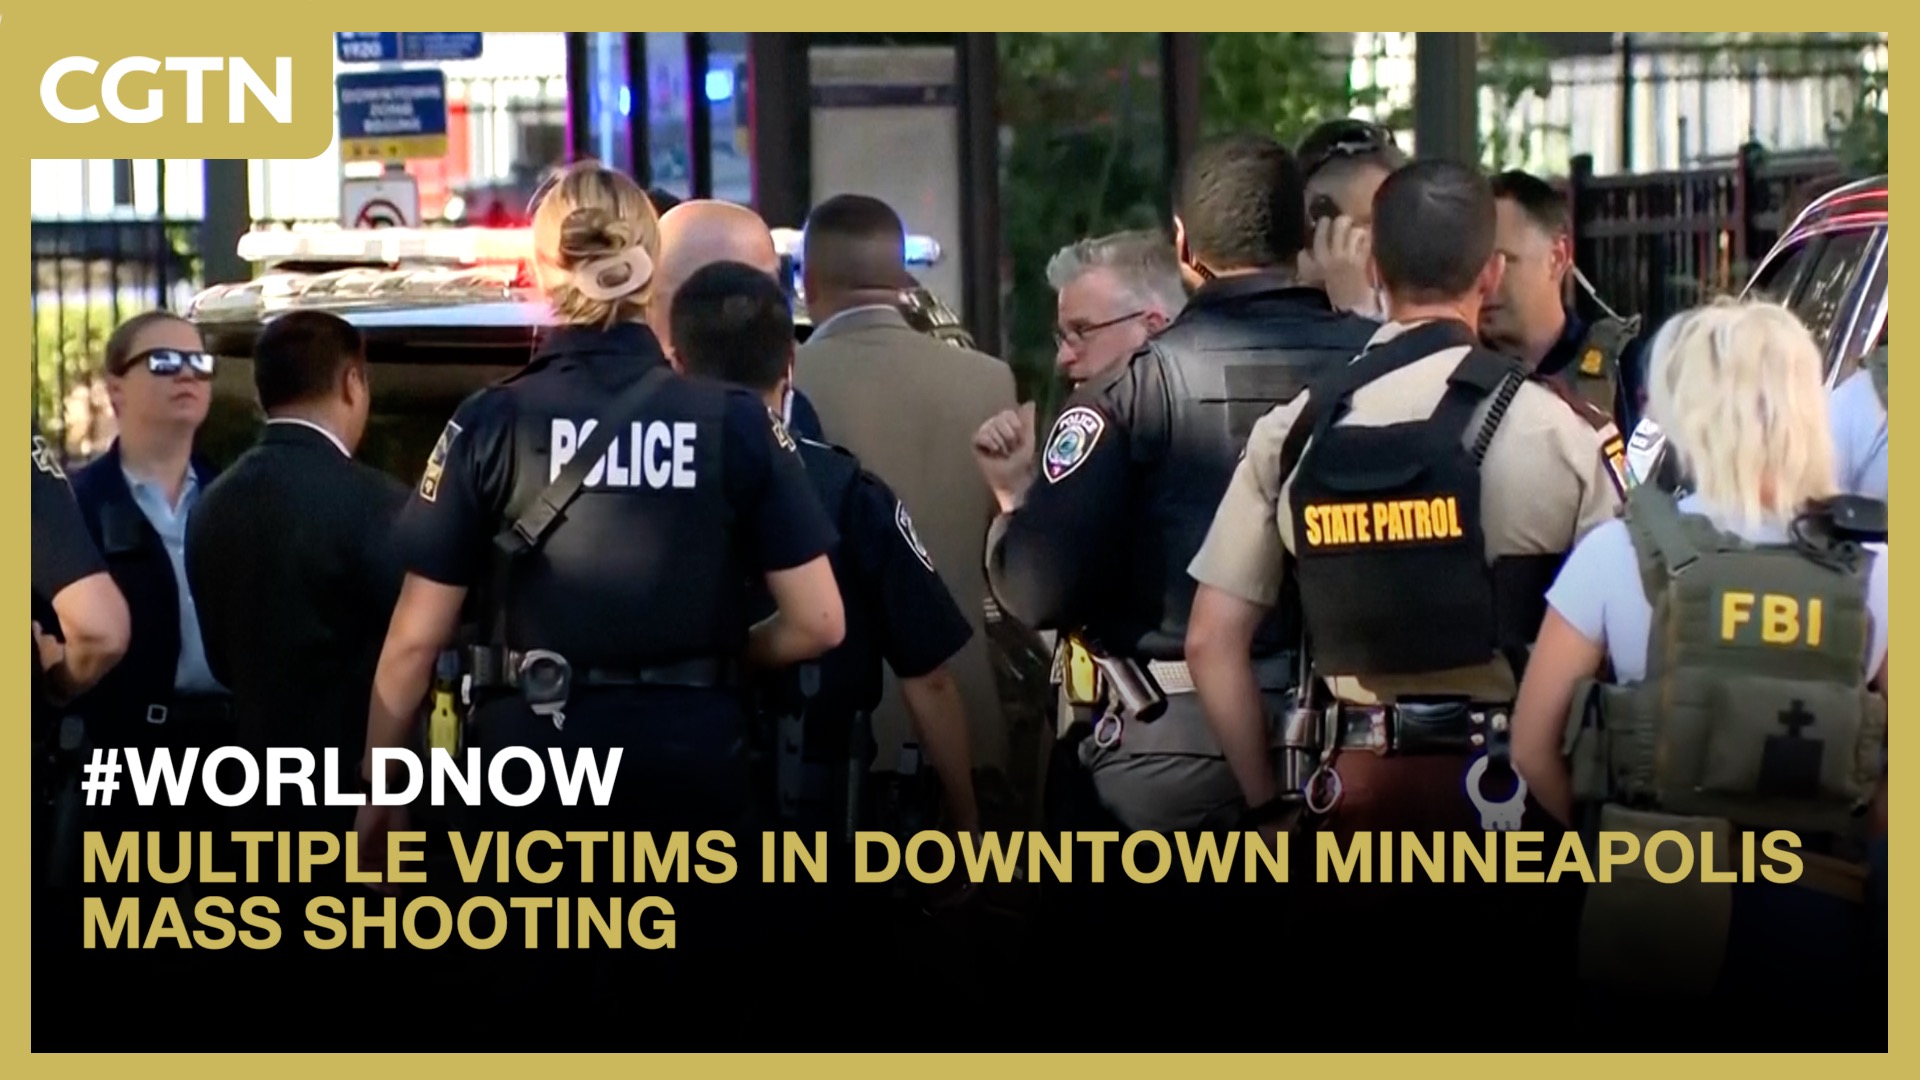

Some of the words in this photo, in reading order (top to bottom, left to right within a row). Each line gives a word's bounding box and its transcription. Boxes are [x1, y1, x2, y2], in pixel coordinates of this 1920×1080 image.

[1060, 413, 1098, 434] POLICE
[1304, 503, 1371, 547] STATE
[1373, 496, 1463, 542] PATROL
[1720, 591, 1823, 648] FBI
